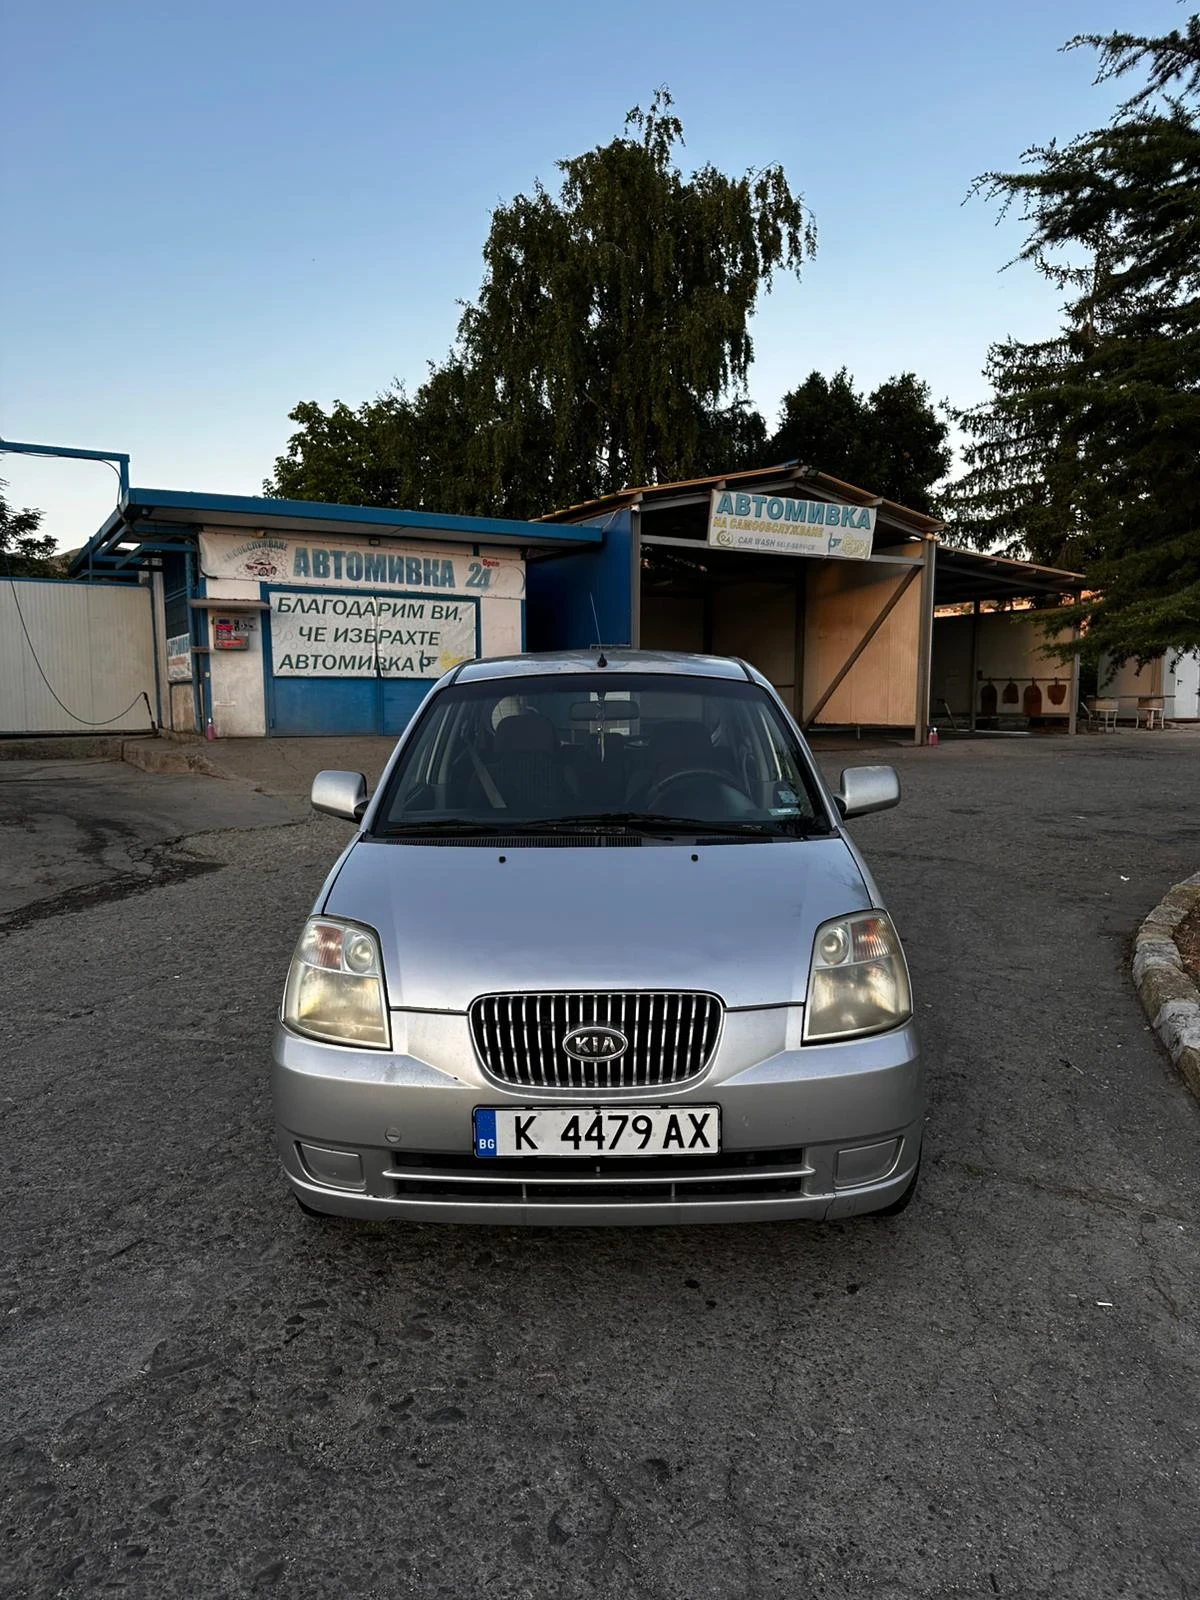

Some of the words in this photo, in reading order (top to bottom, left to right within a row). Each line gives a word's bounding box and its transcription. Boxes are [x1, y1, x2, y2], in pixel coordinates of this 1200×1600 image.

[716, 492, 871, 530] АВТОМИВКА
[737, 536, 753, 545] CAR
[754, 538, 776, 548] WASH
[293, 546, 456, 589] АВТОМИВКА
[465, 562, 493, 591] 24
[277, 597, 425, 619] БЛАГОДАРИМ
[430, 604, 463, 623] ВИ,
[298, 626, 328, 643] ЧЕ
[333, 627, 441, 647] ИЗБРАХТЕ
[278, 653, 415, 672] АВТОМИВКА
[574, 1036, 617, 1054] KIA
[514, 1114, 539, 1151] K
[560, 1114, 653, 1151] 4479
[662, 1112, 711, 1150] AX
[478, 1138, 495, 1150] BG
